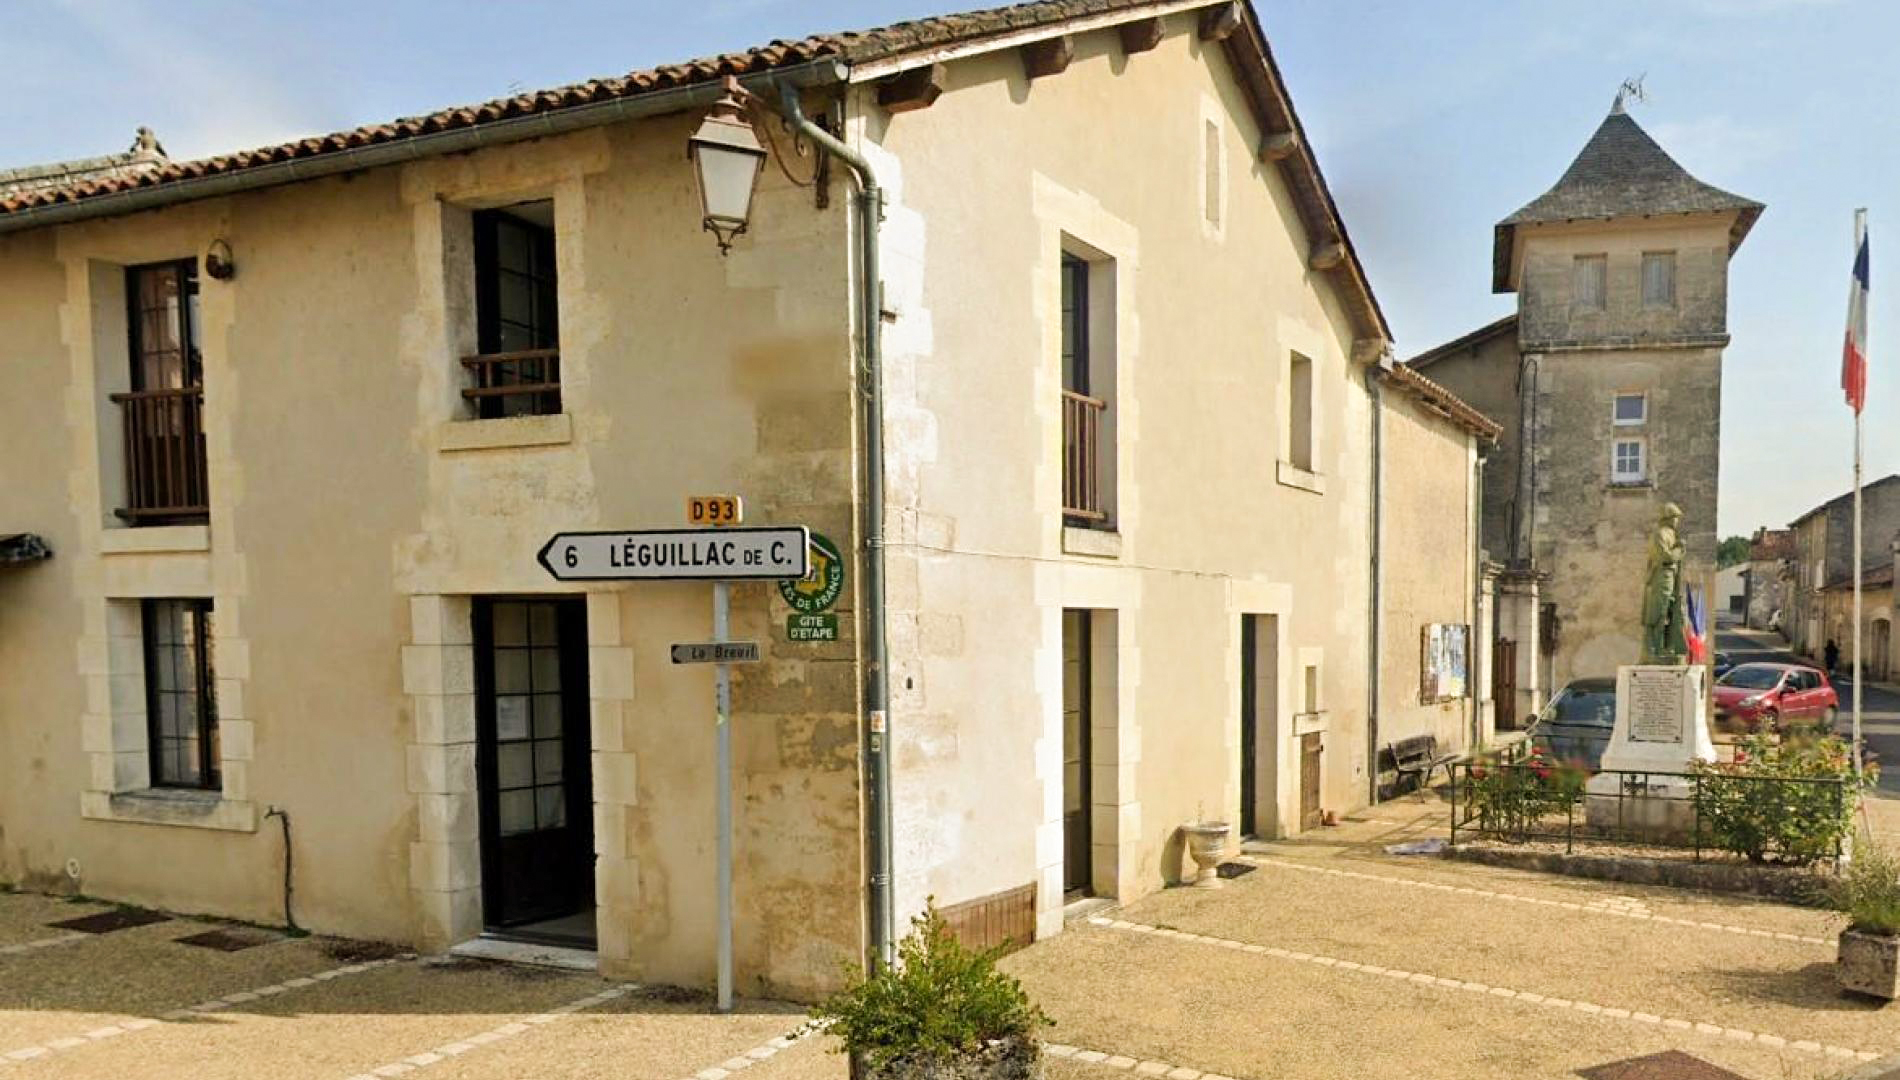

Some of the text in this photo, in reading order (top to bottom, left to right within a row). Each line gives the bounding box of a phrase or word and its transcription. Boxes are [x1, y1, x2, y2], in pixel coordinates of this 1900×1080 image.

[565, 537, 792, 569] 6 LÉGUILLAC DE C.
